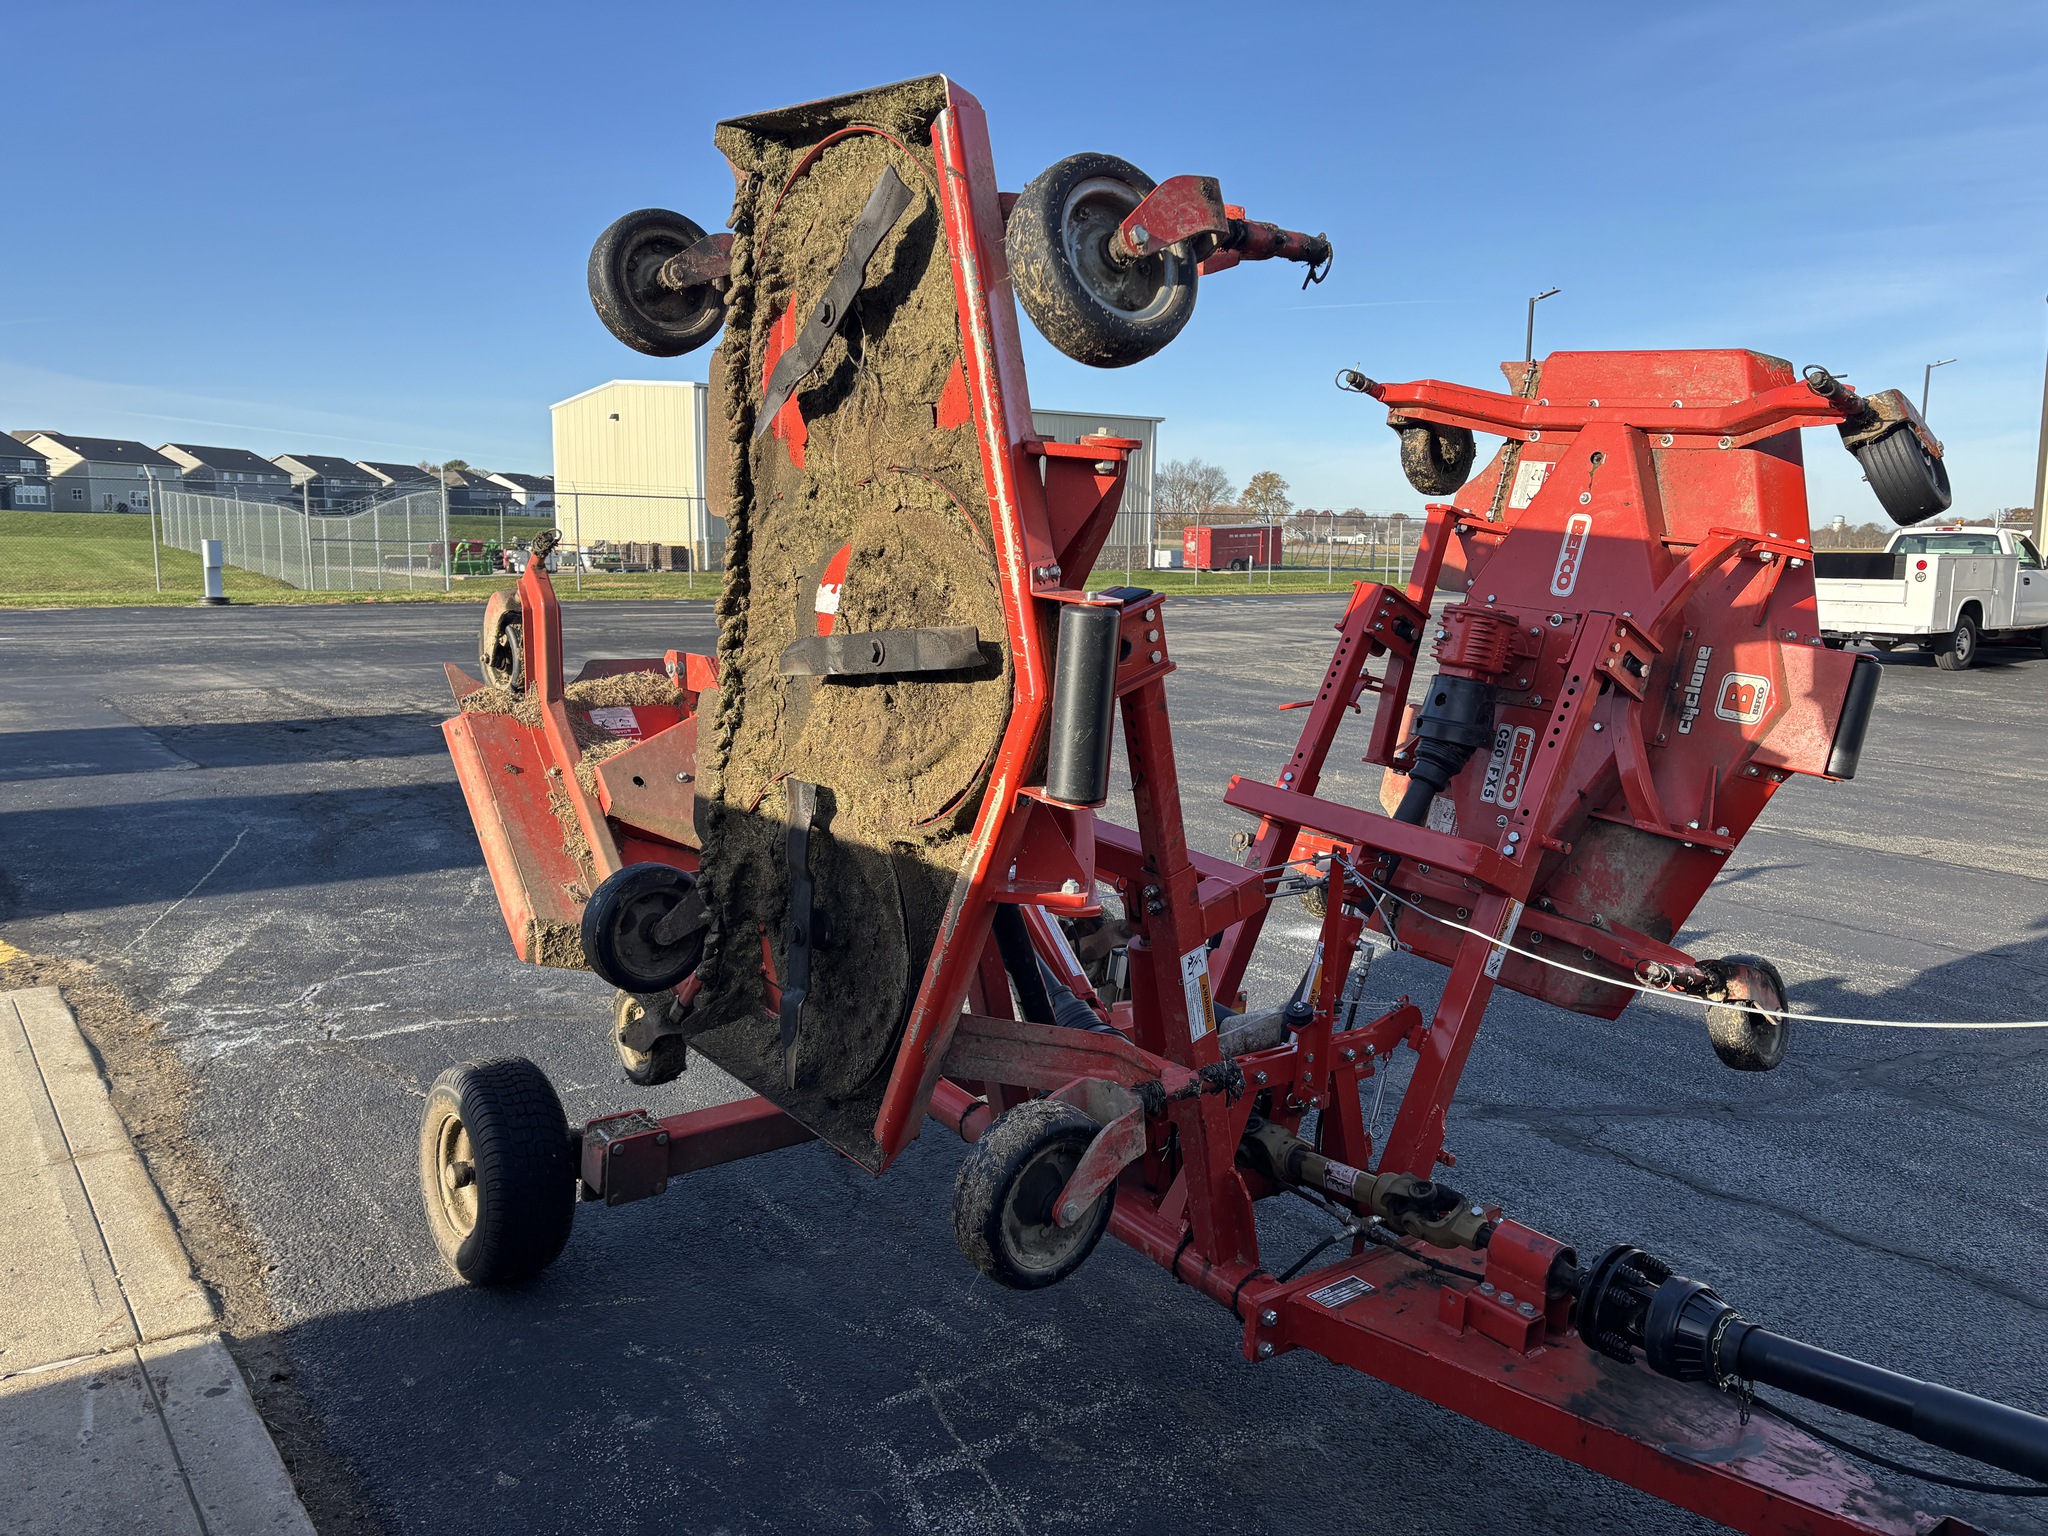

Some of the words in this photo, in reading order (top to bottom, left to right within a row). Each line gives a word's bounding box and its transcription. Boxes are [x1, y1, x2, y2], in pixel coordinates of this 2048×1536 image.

[1556, 520, 1587, 591] BEFCO
[1677, 645, 1713, 734] cyclone
[1722, 682, 1756, 715] B
[1752, 687, 1765, 715] BEFCO
[1494, 729, 1510, 758] C50
[1483, 766, 1500, 798] FX5
[1502, 732, 1531, 803] BEFCO
